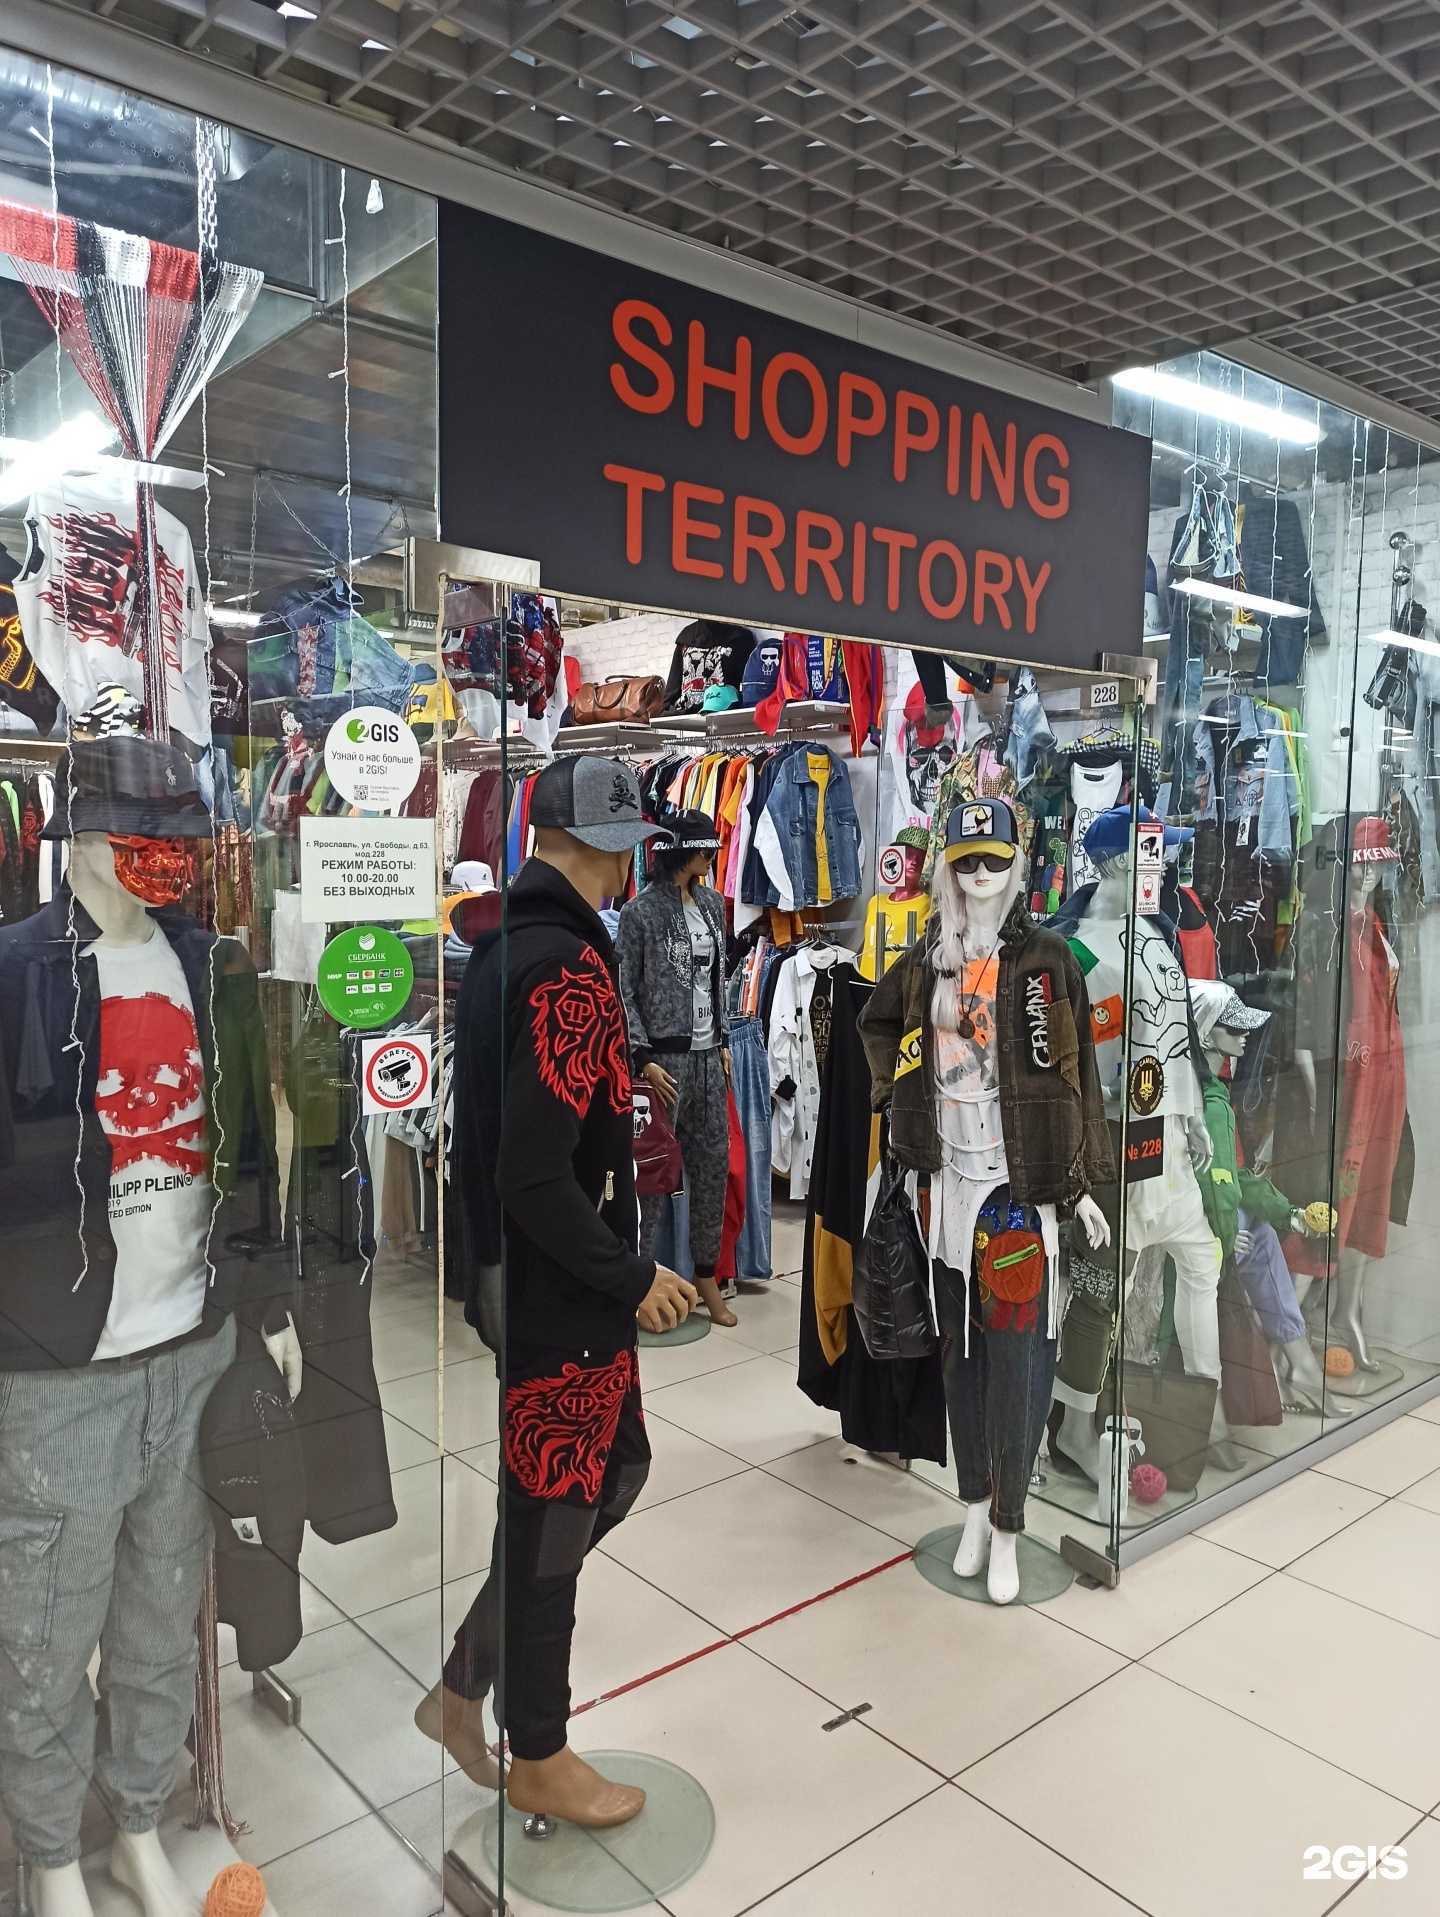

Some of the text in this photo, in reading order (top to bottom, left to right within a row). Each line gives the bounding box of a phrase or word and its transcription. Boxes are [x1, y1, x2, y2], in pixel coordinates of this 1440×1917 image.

[609, 299, 1071, 520] SHOPPING
[603, 463, 1052, 635] TERRITORY
[1094, 685, 1117, 703] 228
[346, 719, 399, 743] 2GIS
[331, 751, 414, 764] Узнай о нас больше
[359, 764, 388, 775] в 2GIS!
[313, 840, 360, 849] Ярославль,
[321, 860, 417, 871] РЕЖИМ РАБОТЫ:
[341, 873, 399, 883] 10.00-20.00
[323, 886, 415, 898] БЕЗ ВЫХОДНЫХ
[348, 952, 386, 962] СБЕРБАНК
[378, 1049, 417, 1064] ВЕДЕТСЯ
[1141, 1138, 1162, 1158] 228
[125, 1204, 152, 1216] EDITION
